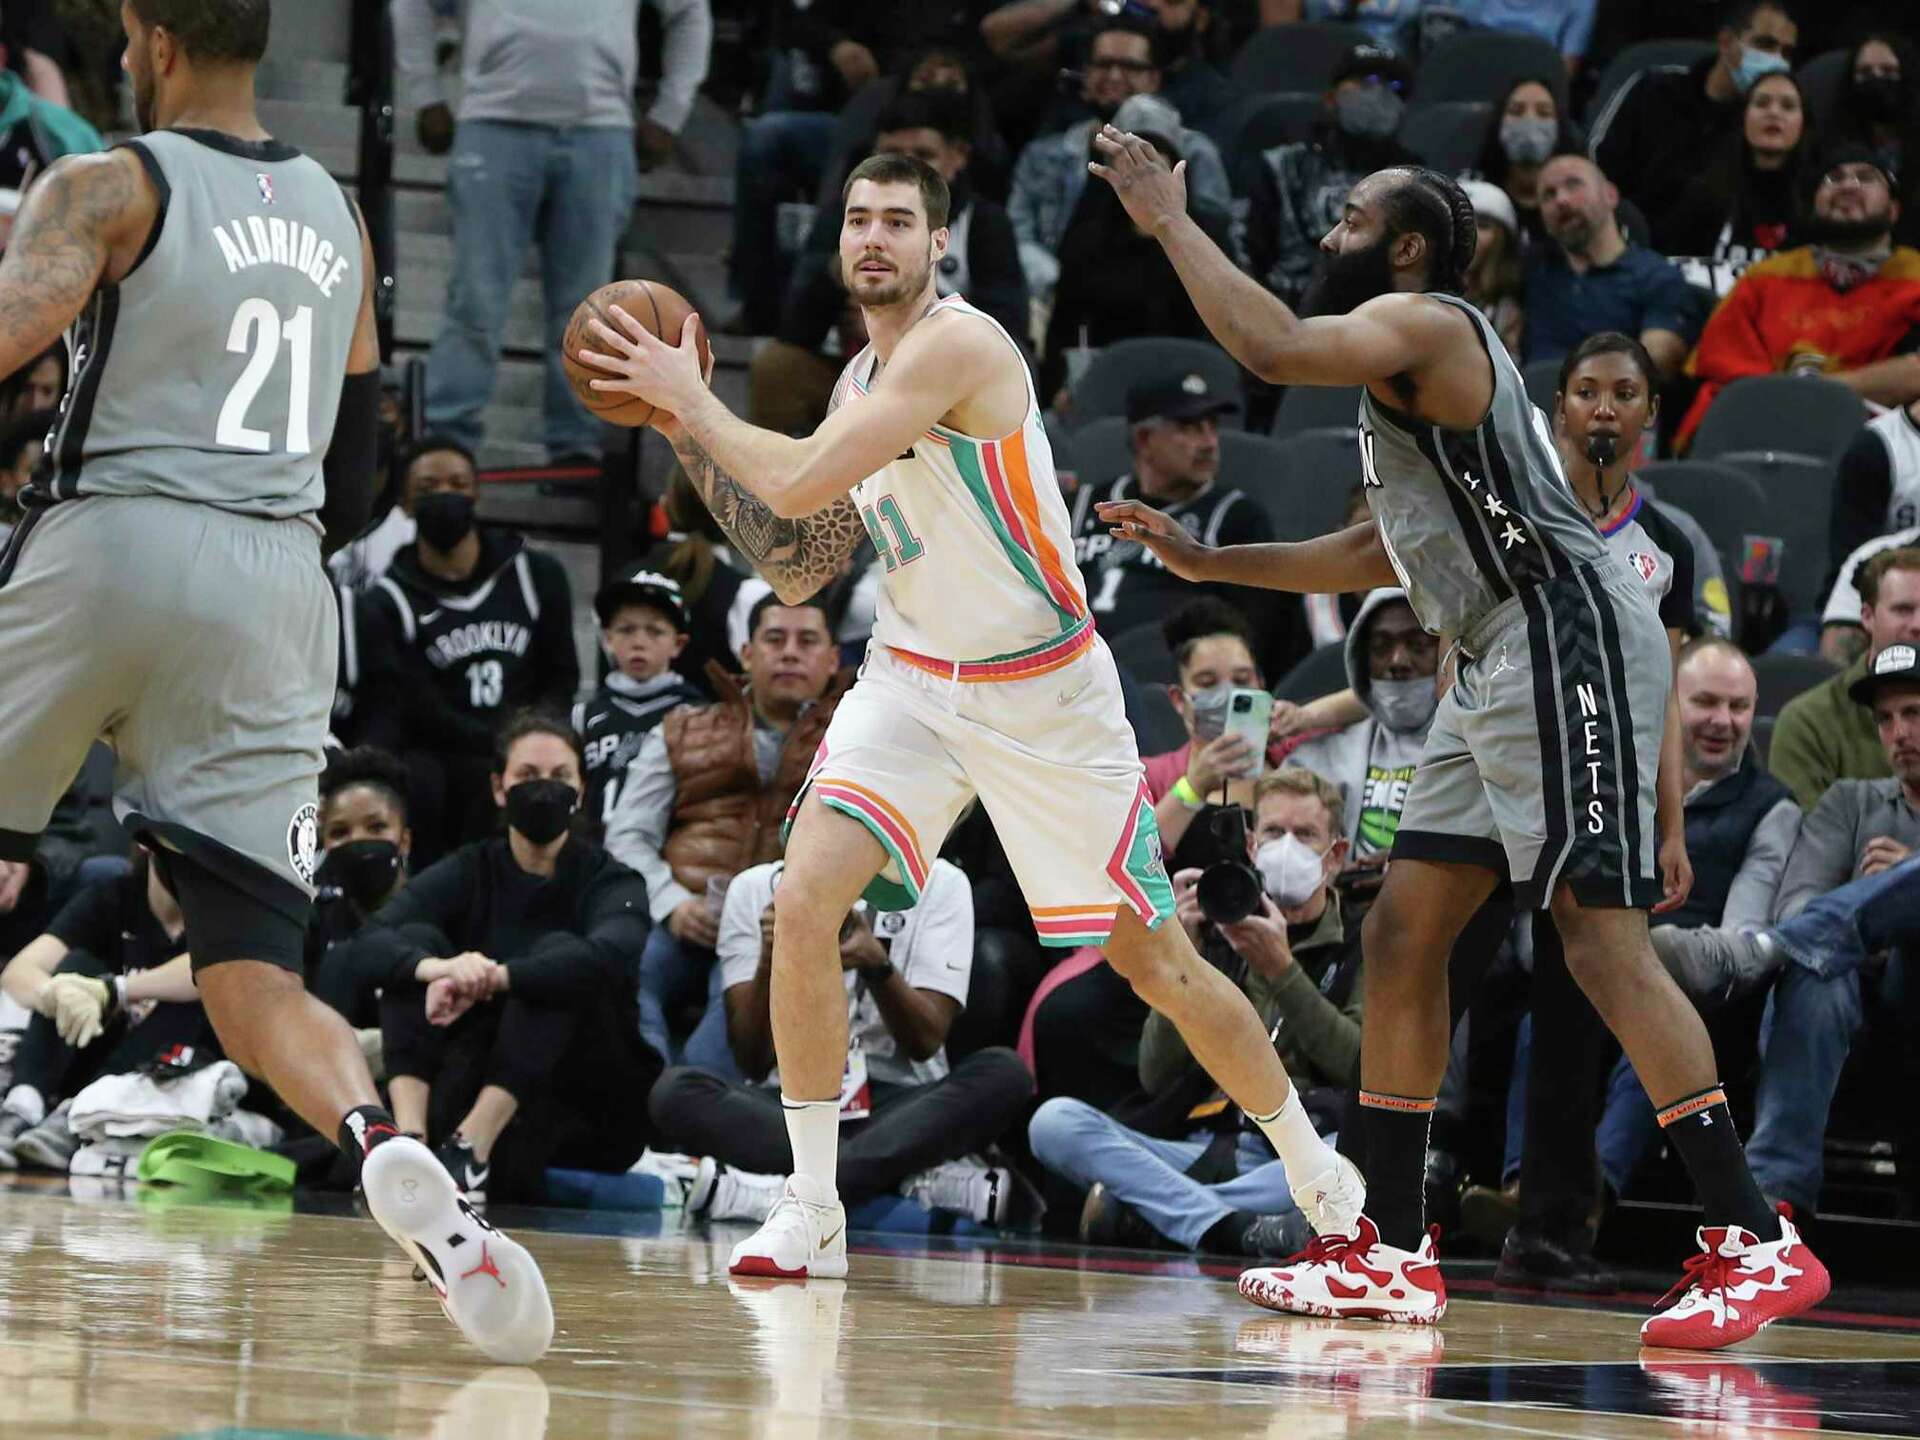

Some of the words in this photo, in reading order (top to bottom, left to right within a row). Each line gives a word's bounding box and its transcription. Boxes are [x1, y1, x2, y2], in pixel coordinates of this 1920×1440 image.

[213, 215, 348, 298] ALDRIDGE
[215, 298, 312, 454] 21
[425, 621, 531, 668] BROOKLYN
[465, 660, 503, 707] 13
[1576, 683, 1604, 834] NETS
